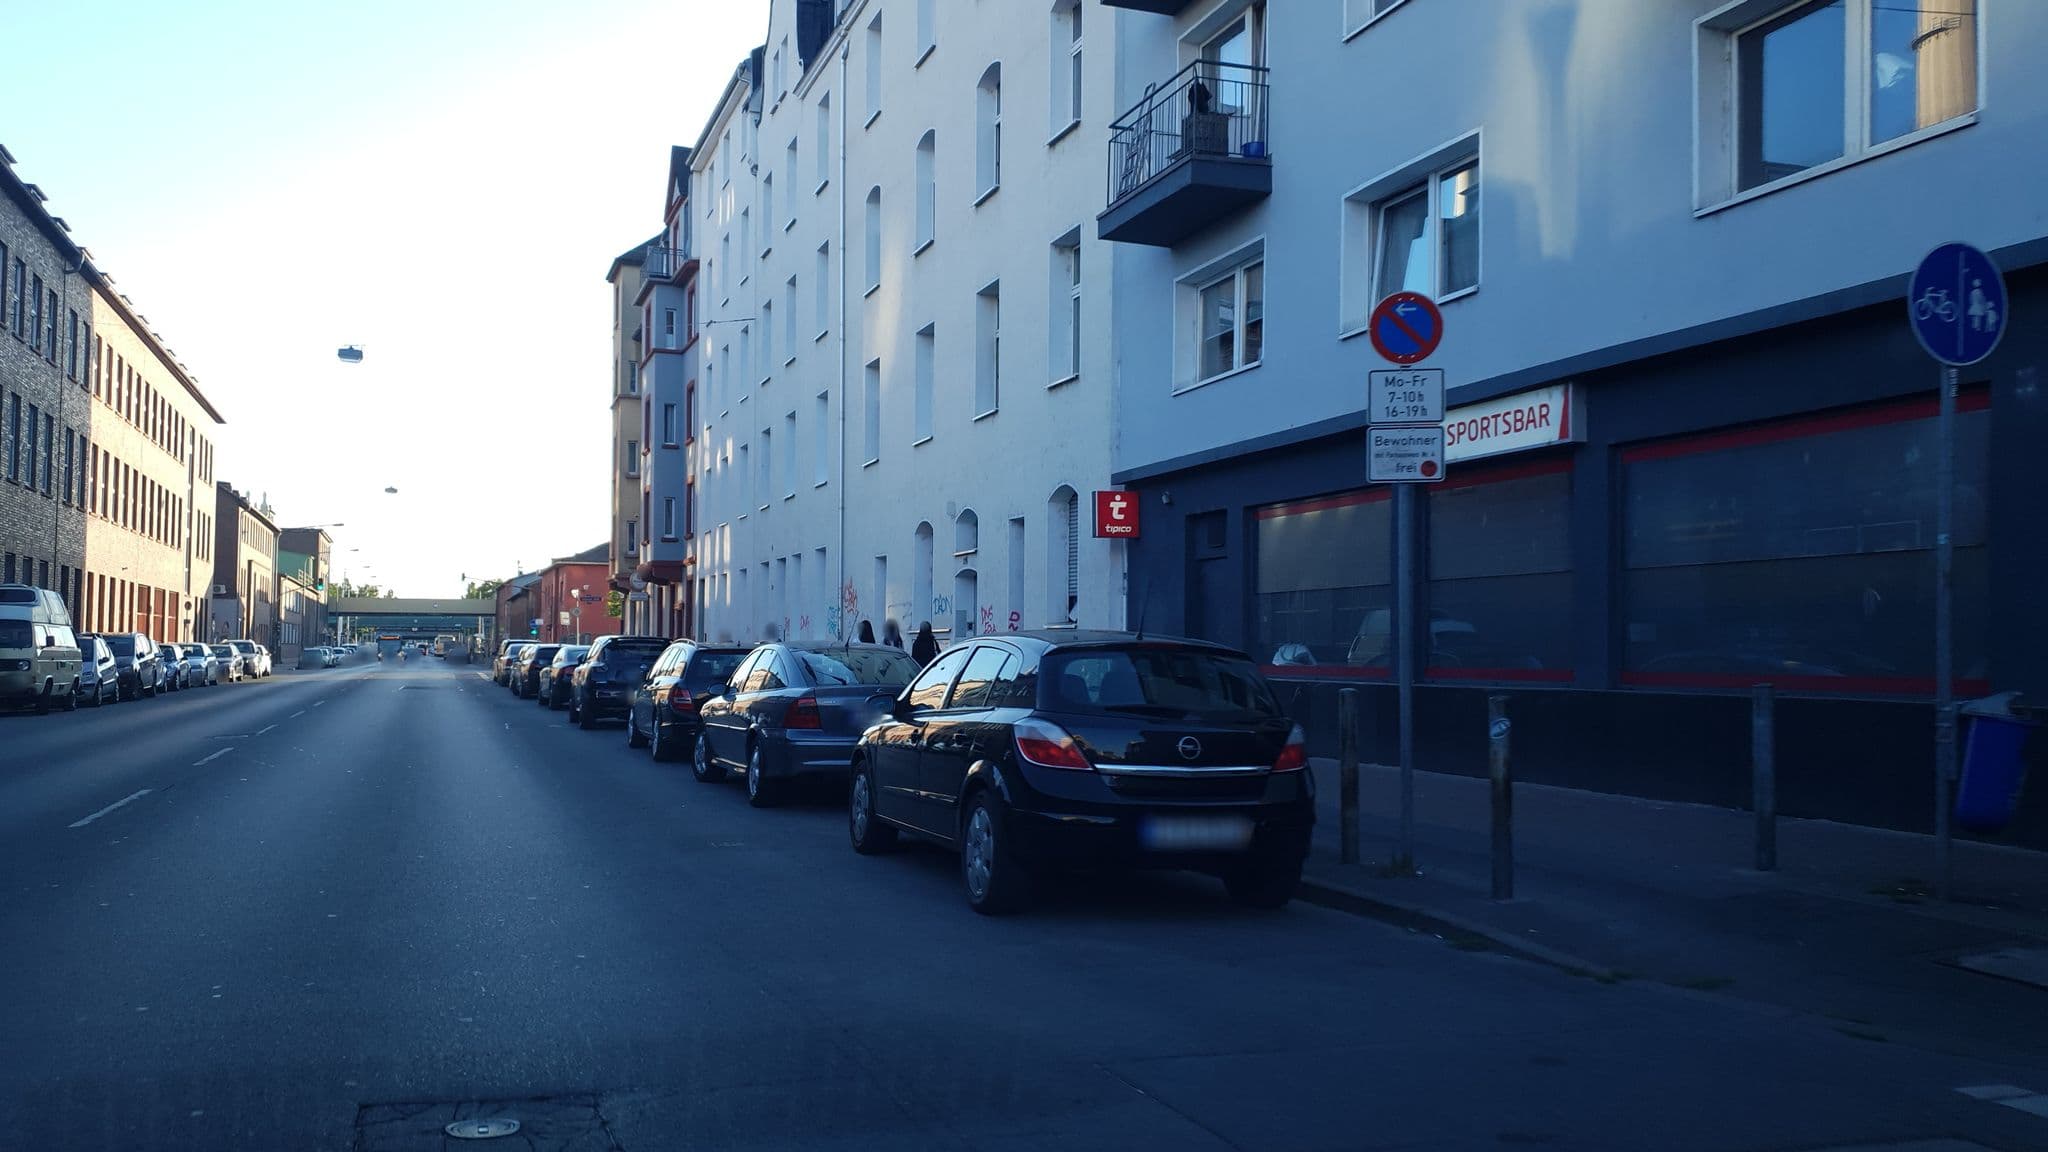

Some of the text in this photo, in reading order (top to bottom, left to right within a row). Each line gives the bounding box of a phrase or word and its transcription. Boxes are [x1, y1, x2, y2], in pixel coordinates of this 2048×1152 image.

[1384, 374, 1428, 387] Mo-Fr
[1446, 403, 1550, 447] SPORTSBAR
[1375, 435, 1439, 447] Bewohner
[1395, 462, 1417, 473] frei
[1104, 523, 1132, 535] tipico
